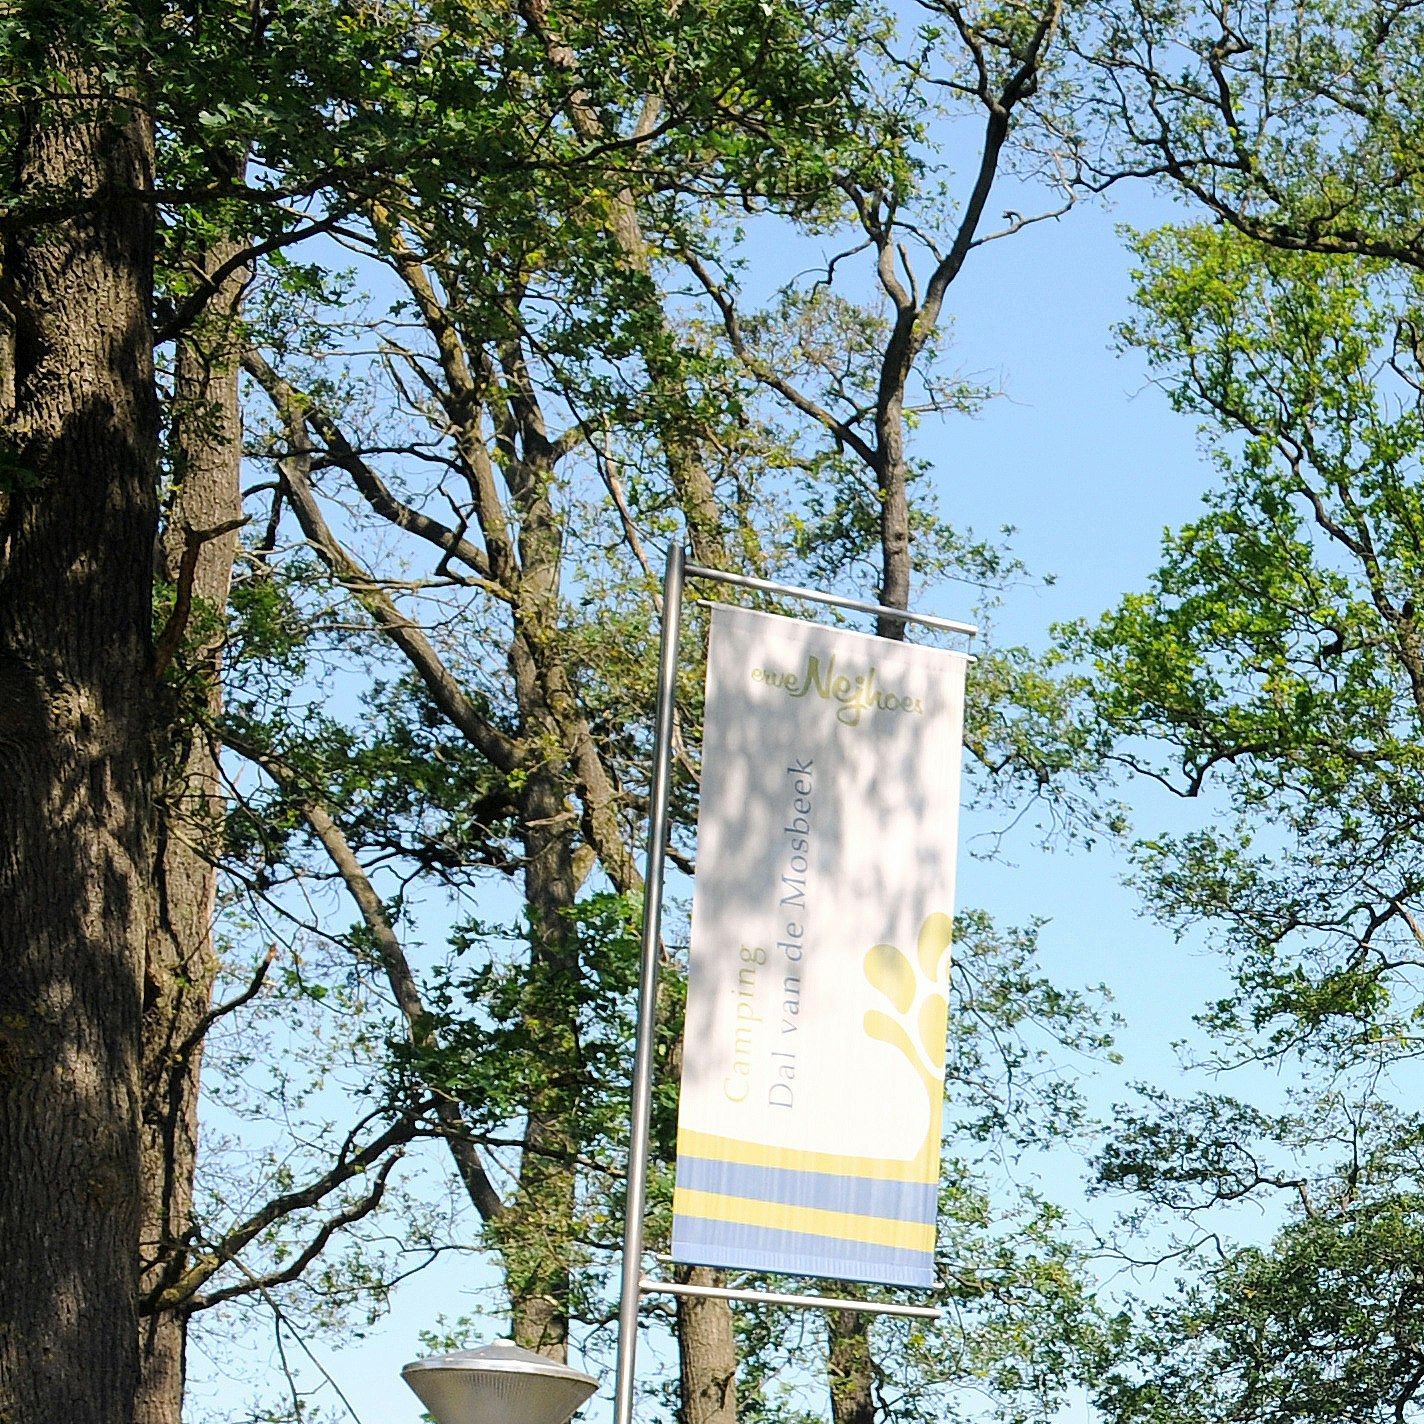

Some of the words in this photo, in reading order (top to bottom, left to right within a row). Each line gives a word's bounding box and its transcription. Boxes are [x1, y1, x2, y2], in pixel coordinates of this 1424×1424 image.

[752, 667, 799, 698] erve
[796, 653, 924, 727] Nejhoes
[779, 757, 814, 910] Mosbeek
[776, 921, 805, 962] de
[724, 943, 767, 1103] Camping
[780, 974, 802, 1035] van
[768, 1051, 796, 1110] Dal
